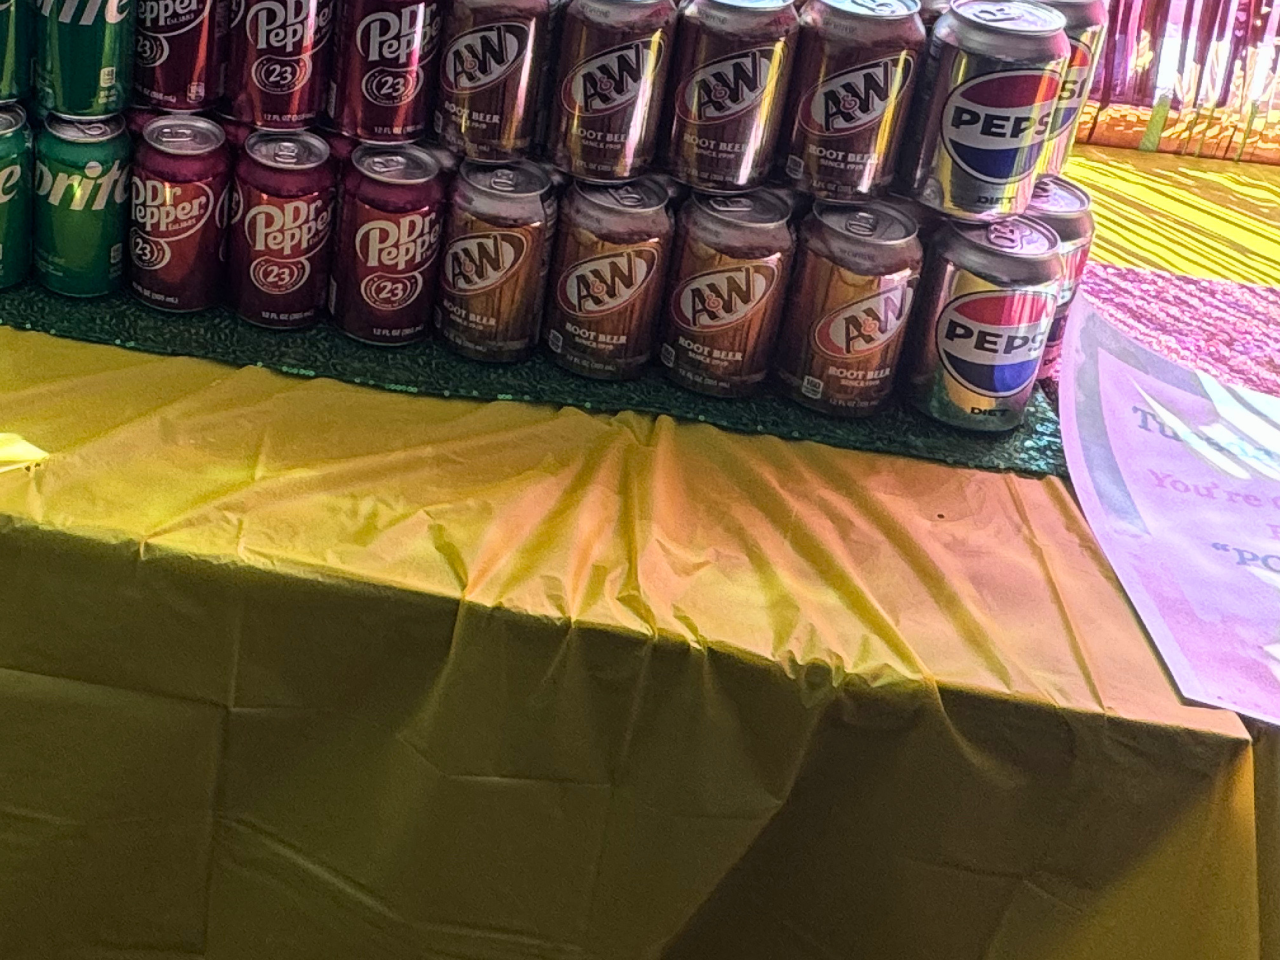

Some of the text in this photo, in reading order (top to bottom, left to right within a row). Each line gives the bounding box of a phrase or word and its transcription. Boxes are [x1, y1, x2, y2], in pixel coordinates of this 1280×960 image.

[356, 11, 441, 65] Peppe
[452, 25, 509, 90] A&W
[268, 63, 292, 85] 23
[380, 76, 406, 97] 23
[581, 42, 645, 113] A&W
[696, 49, 762, 122] A&W
[822, 56, 893, 132] A&W
[471, 111, 501, 124] BEER
[951, 106, 1054, 139] PEPS
[606, 133, 628, 143] BEE
[807, 143, 846, 160] ROOT
[145, 179, 182, 206] Dr
[976, 195, 1017, 206] DIET
[283, 199, 323, 230] Dr
[399, 212, 437, 246] Dr
[134, 237, 152, 260] 23
[355, 220, 442, 271] Peppe
[266, 265, 291, 286] 23
[450, 234, 506, 289] A&W
[378, 281, 404, 301] 23
[574, 250, 638, 314] A&W
[687, 265, 757, 328] A&W
[468, 313, 497, 326] BEER
[565, 321, 597, 340] ROOT
[598, 334, 628, 345] BEER
[841, 283, 909, 355] A&W
[678, 335, 743, 361] ROOT BEER
[944, 318, 1046, 356] PEPS
[828, 365, 891, 380] ROOT BEER
[970, 406, 1008, 417] DIET
[1147, 468, 1264, 509] You're
